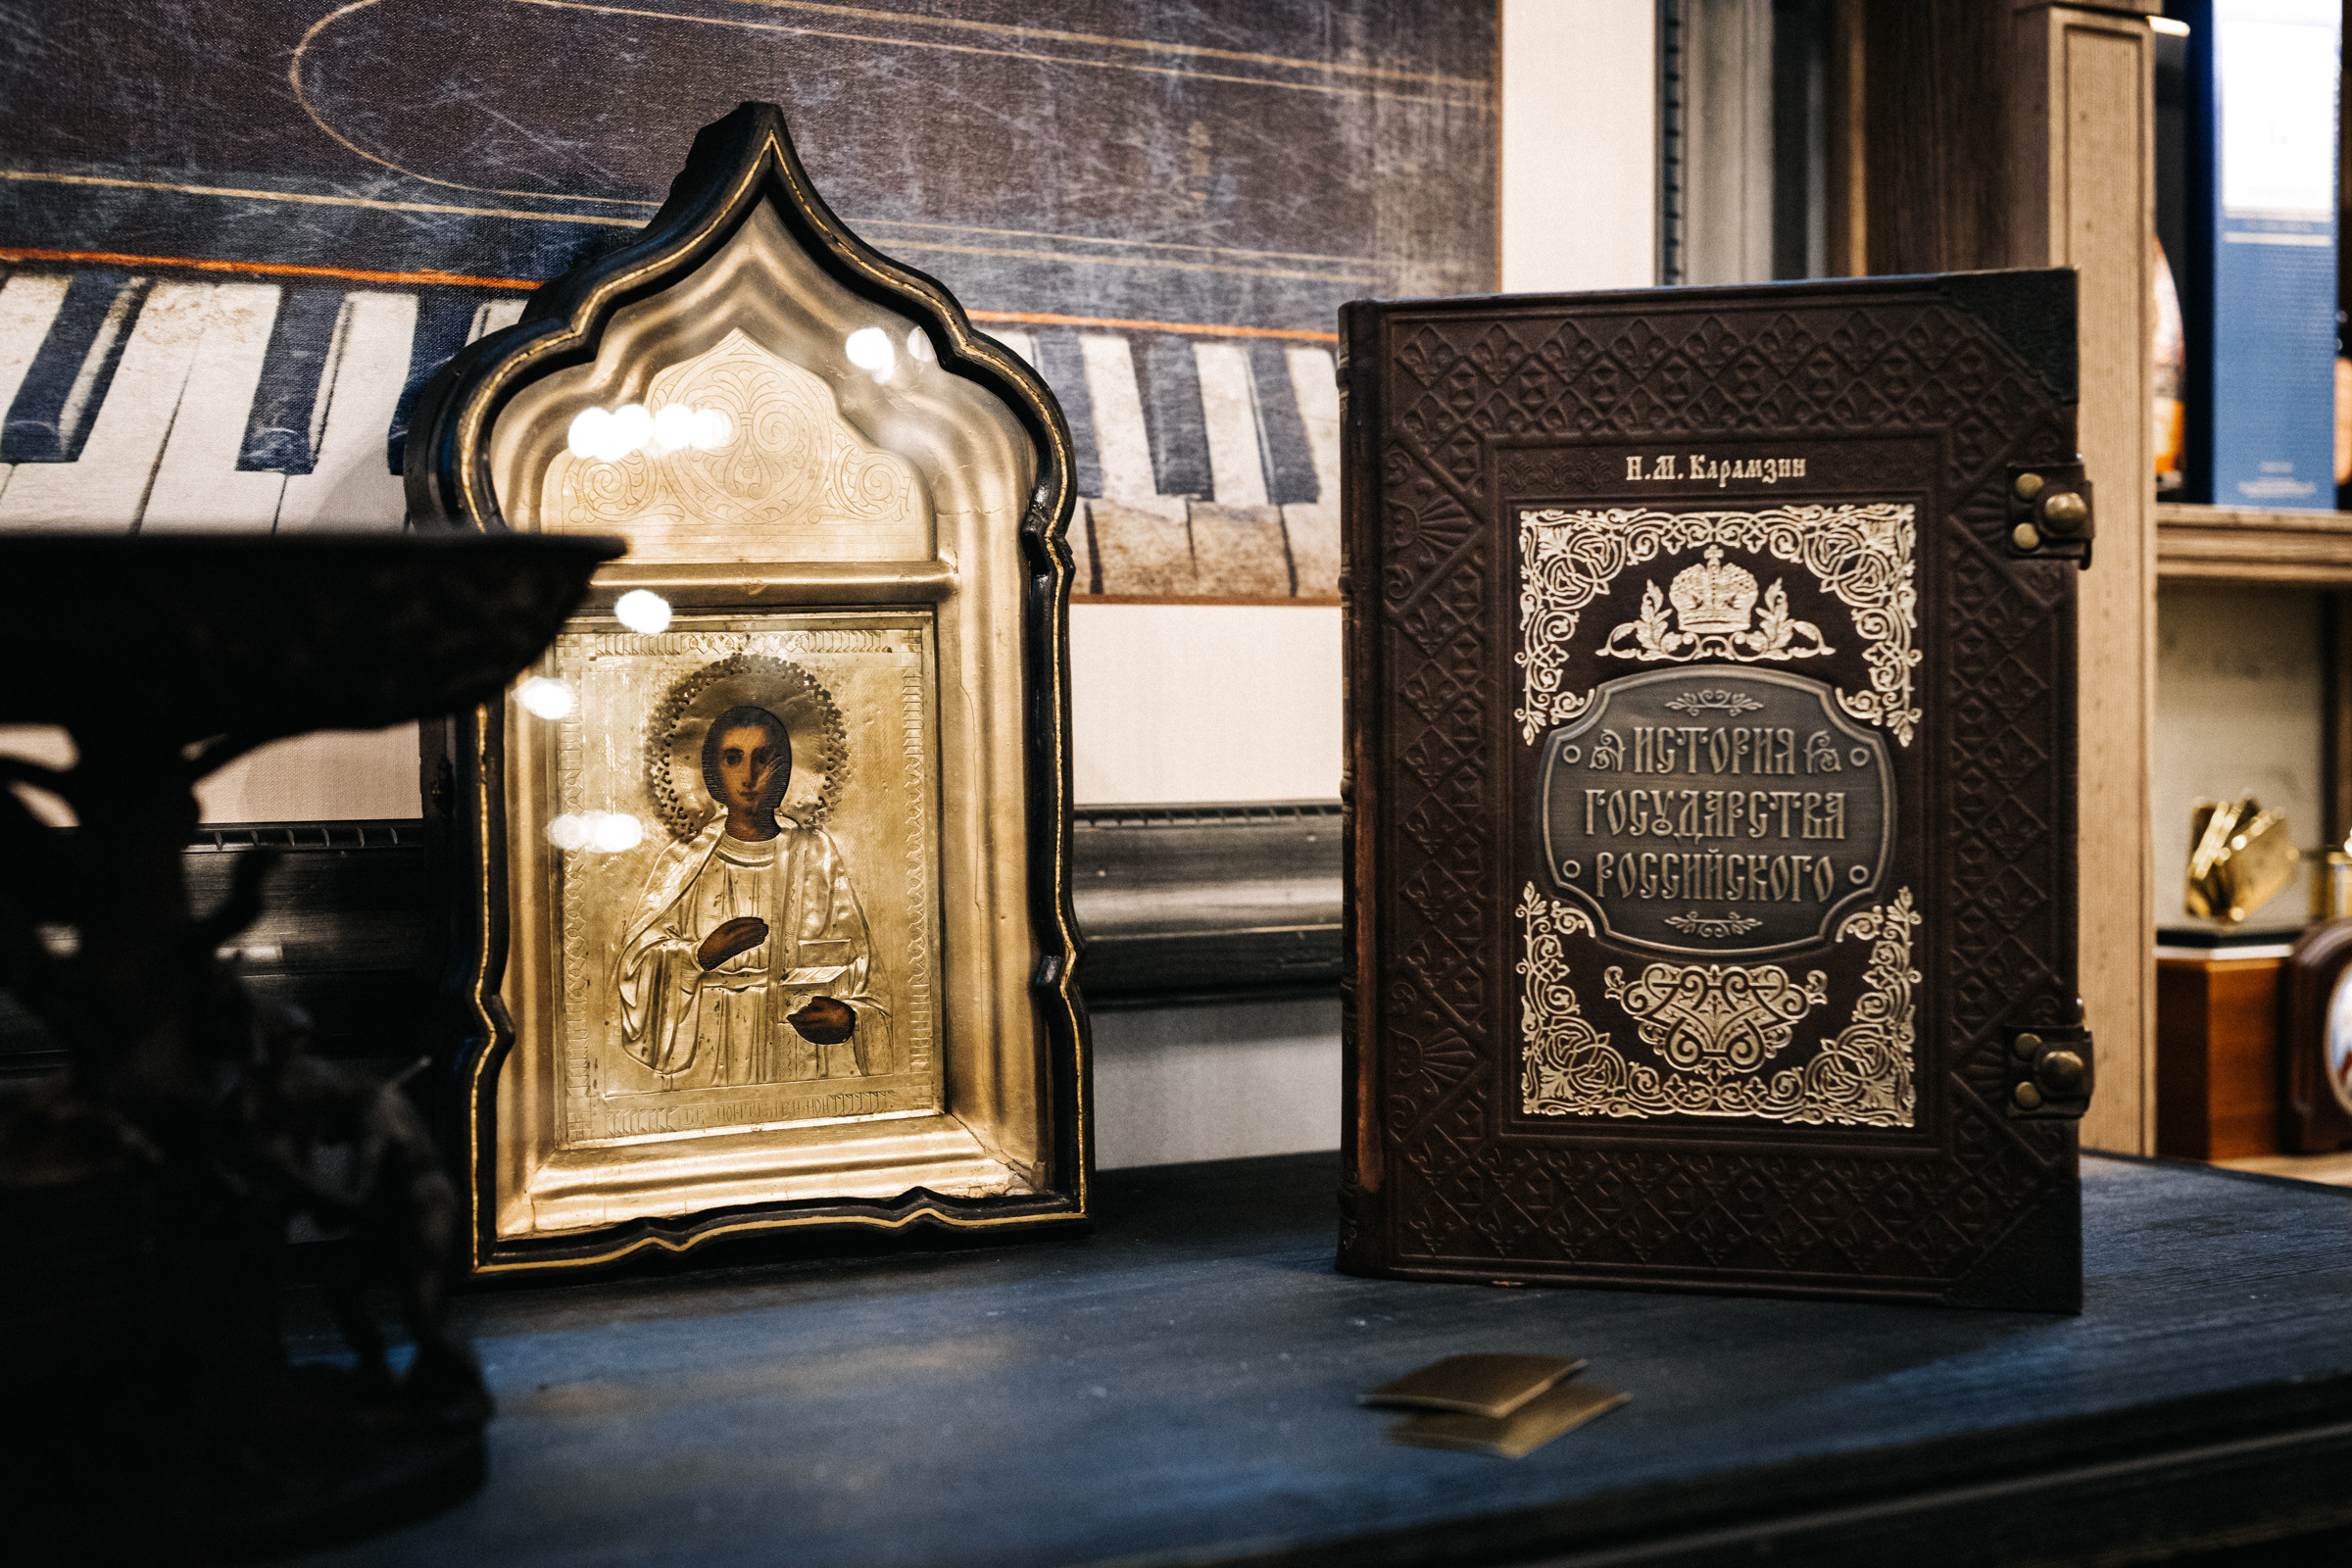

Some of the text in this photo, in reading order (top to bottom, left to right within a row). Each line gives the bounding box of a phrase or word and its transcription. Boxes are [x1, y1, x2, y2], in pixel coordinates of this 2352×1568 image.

[1626, 454, 1807, 488] Н.М. Карамзин
[1633, 726, 1795, 775] ИСТОРИЯ
[1585, 789, 1845, 845] ГОСУДАРСТВА
[1595, 848, 1836, 904] РОССИЙСКОГО
